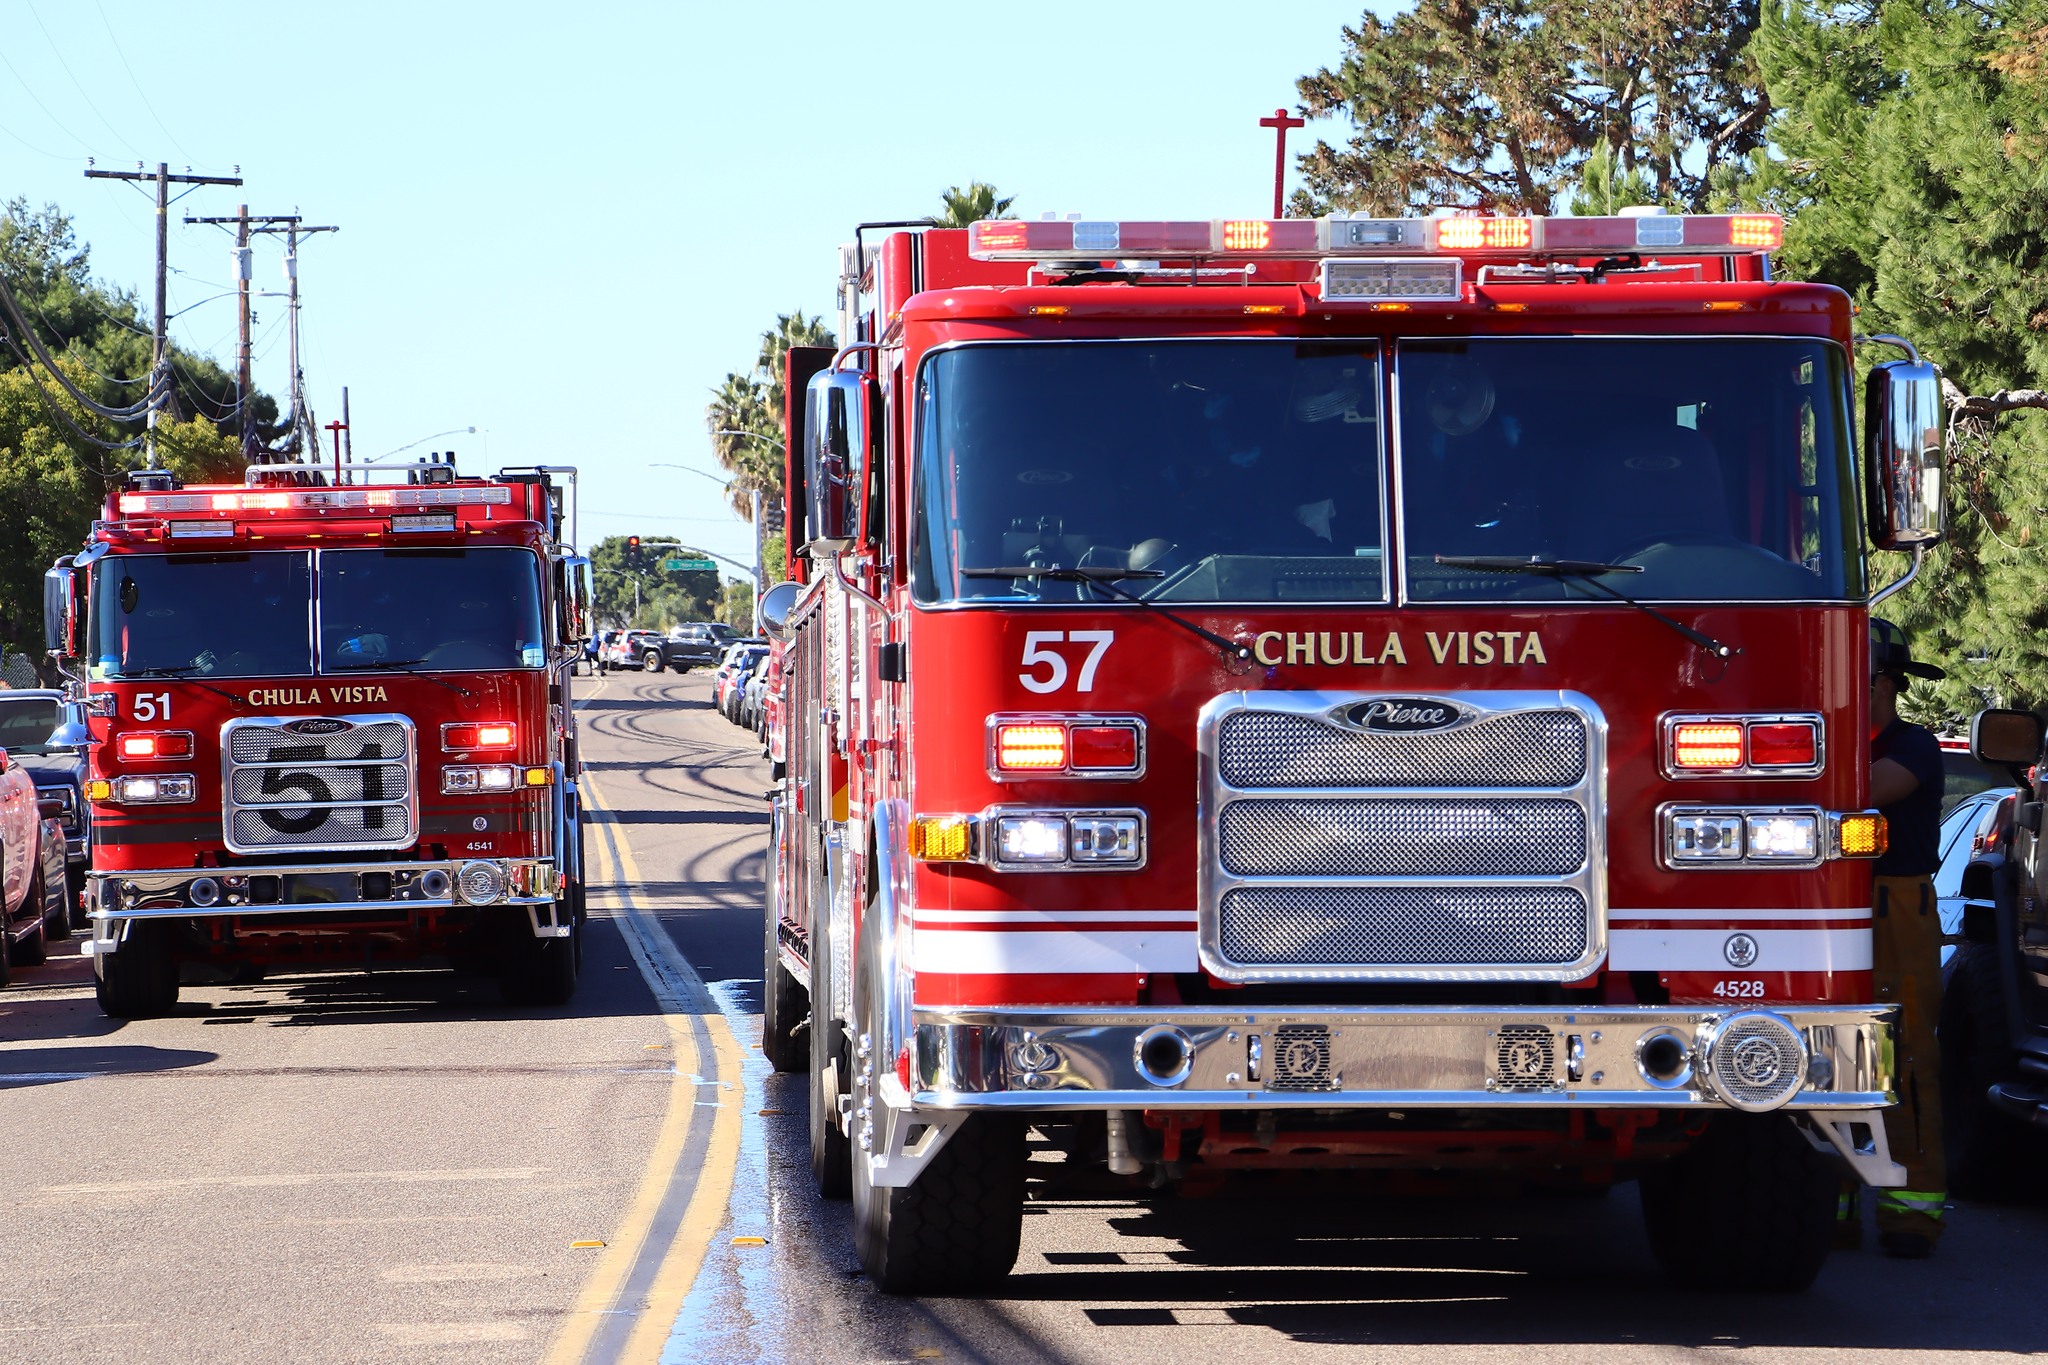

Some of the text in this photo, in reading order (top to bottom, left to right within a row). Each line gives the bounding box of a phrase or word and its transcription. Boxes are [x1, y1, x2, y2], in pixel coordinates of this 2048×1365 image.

[1018, 630, 1114, 694] 57
[1254, 631, 1547, 666] CHULA VISTA
[133, 692, 171, 722] 51
[248, 686, 388, 707] CHULA VISTA
[297, 719, 340, 734] Pierce
[1361, 700, 1447, 728] Pierce
[260, 743, 385, 835] 51
[466, 841, 493, 851] 4541
[1713, 980, 1765, 998] 4528
